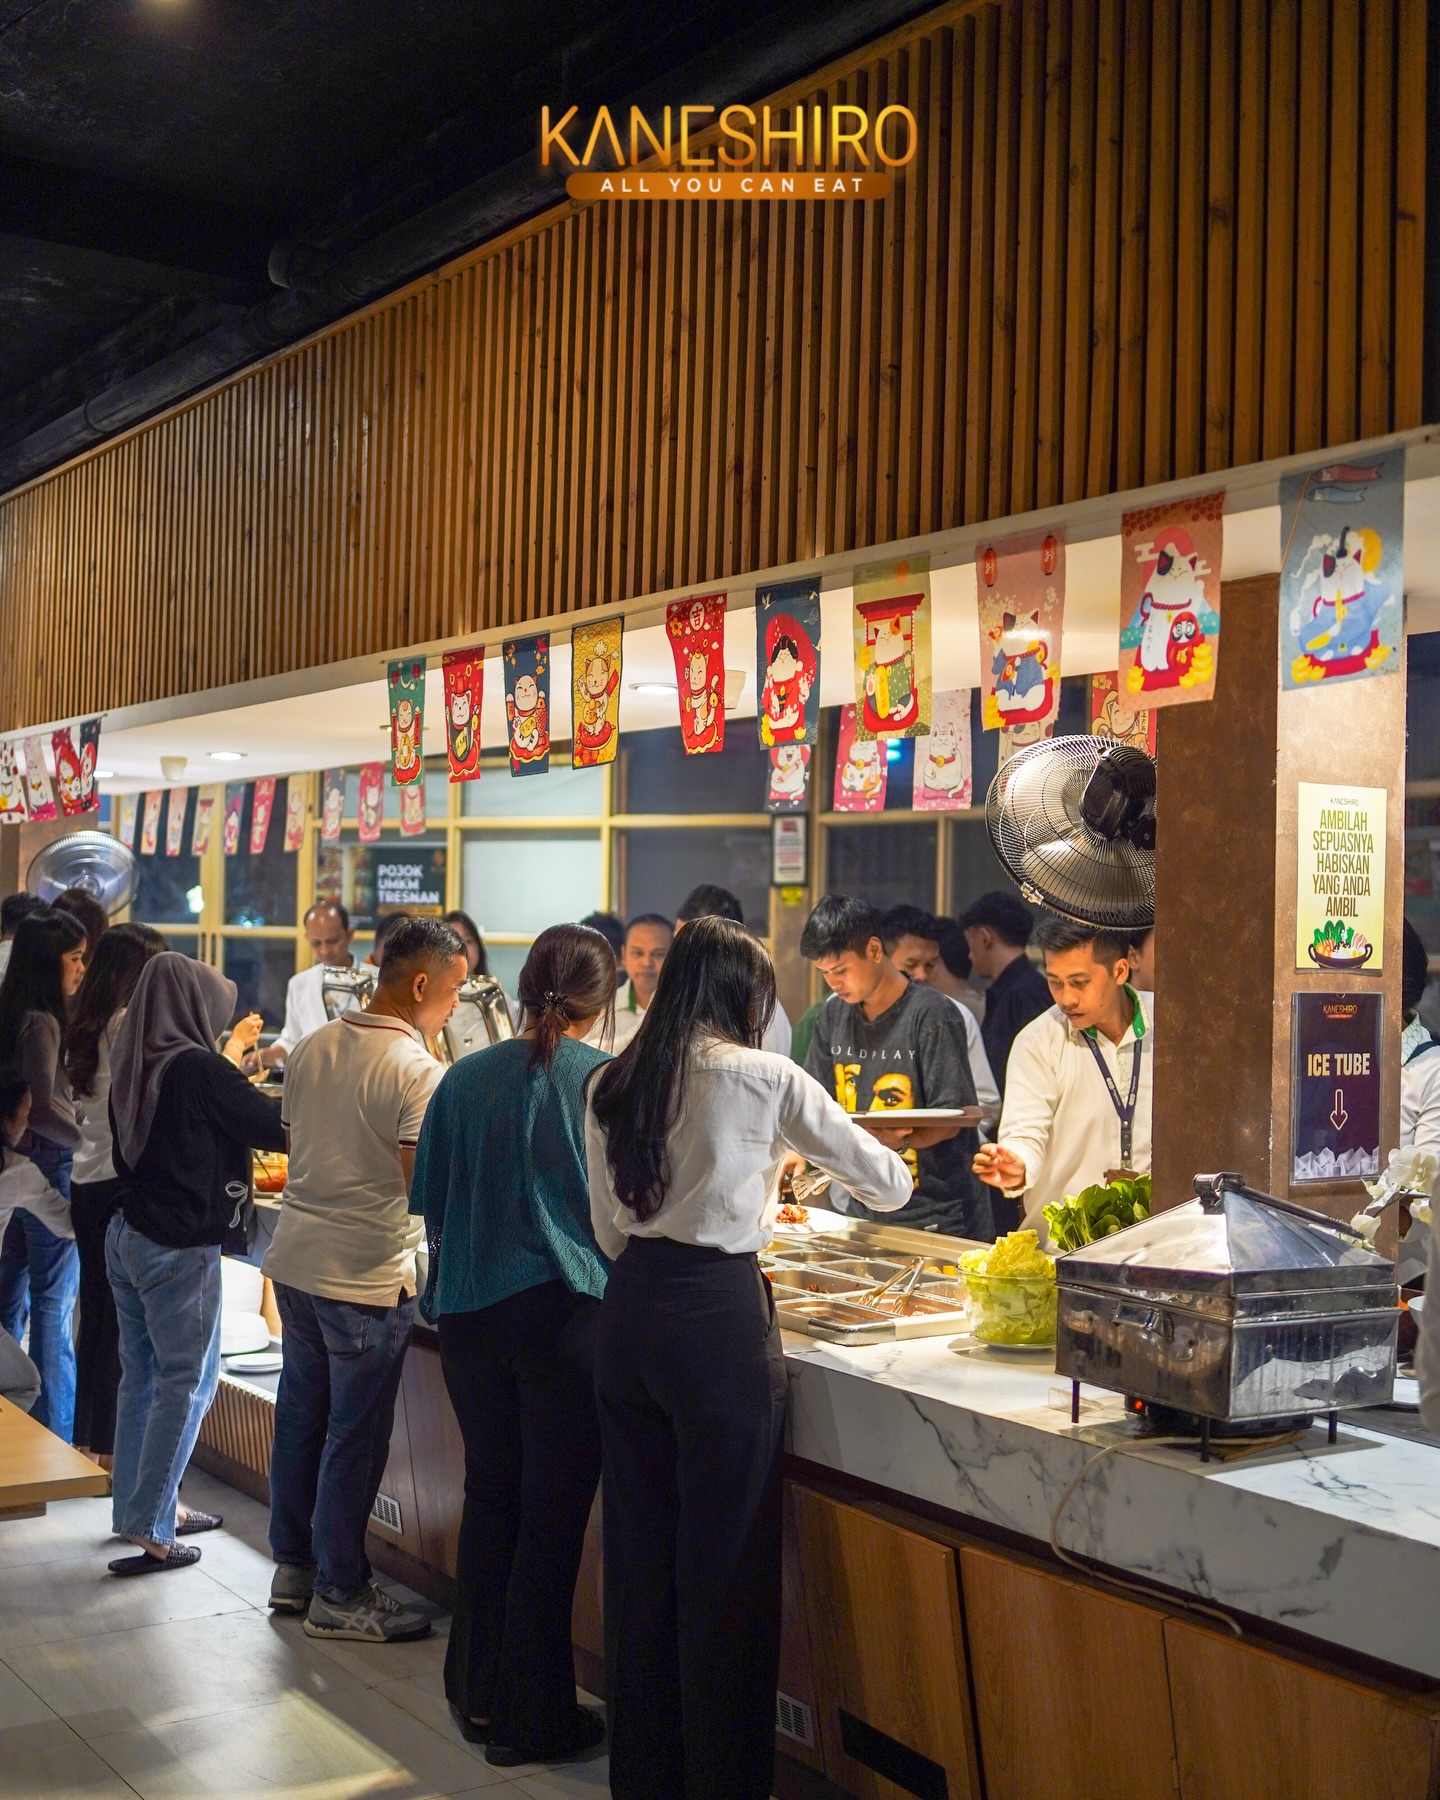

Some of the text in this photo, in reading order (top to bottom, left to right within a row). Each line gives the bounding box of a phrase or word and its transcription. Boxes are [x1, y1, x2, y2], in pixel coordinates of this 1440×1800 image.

[1319, 809, 1368, 831] AMBILAH
[1313, 830, 1374, 853] SEPUASNYA
[378, 864, 423, 877] POJOK
[1317, 853, 1370, 875] HABISKAN
[1312, 874, 1371, 896] YANG ANDA
[378, 890, 440, 903] TRESNAN
[1325, 896, 1359, 917] AMBIL
[1323, 1004, 1358, 1014] KANESHIRO
[1307, 1053, 1371, 1077] ICE TUBE
